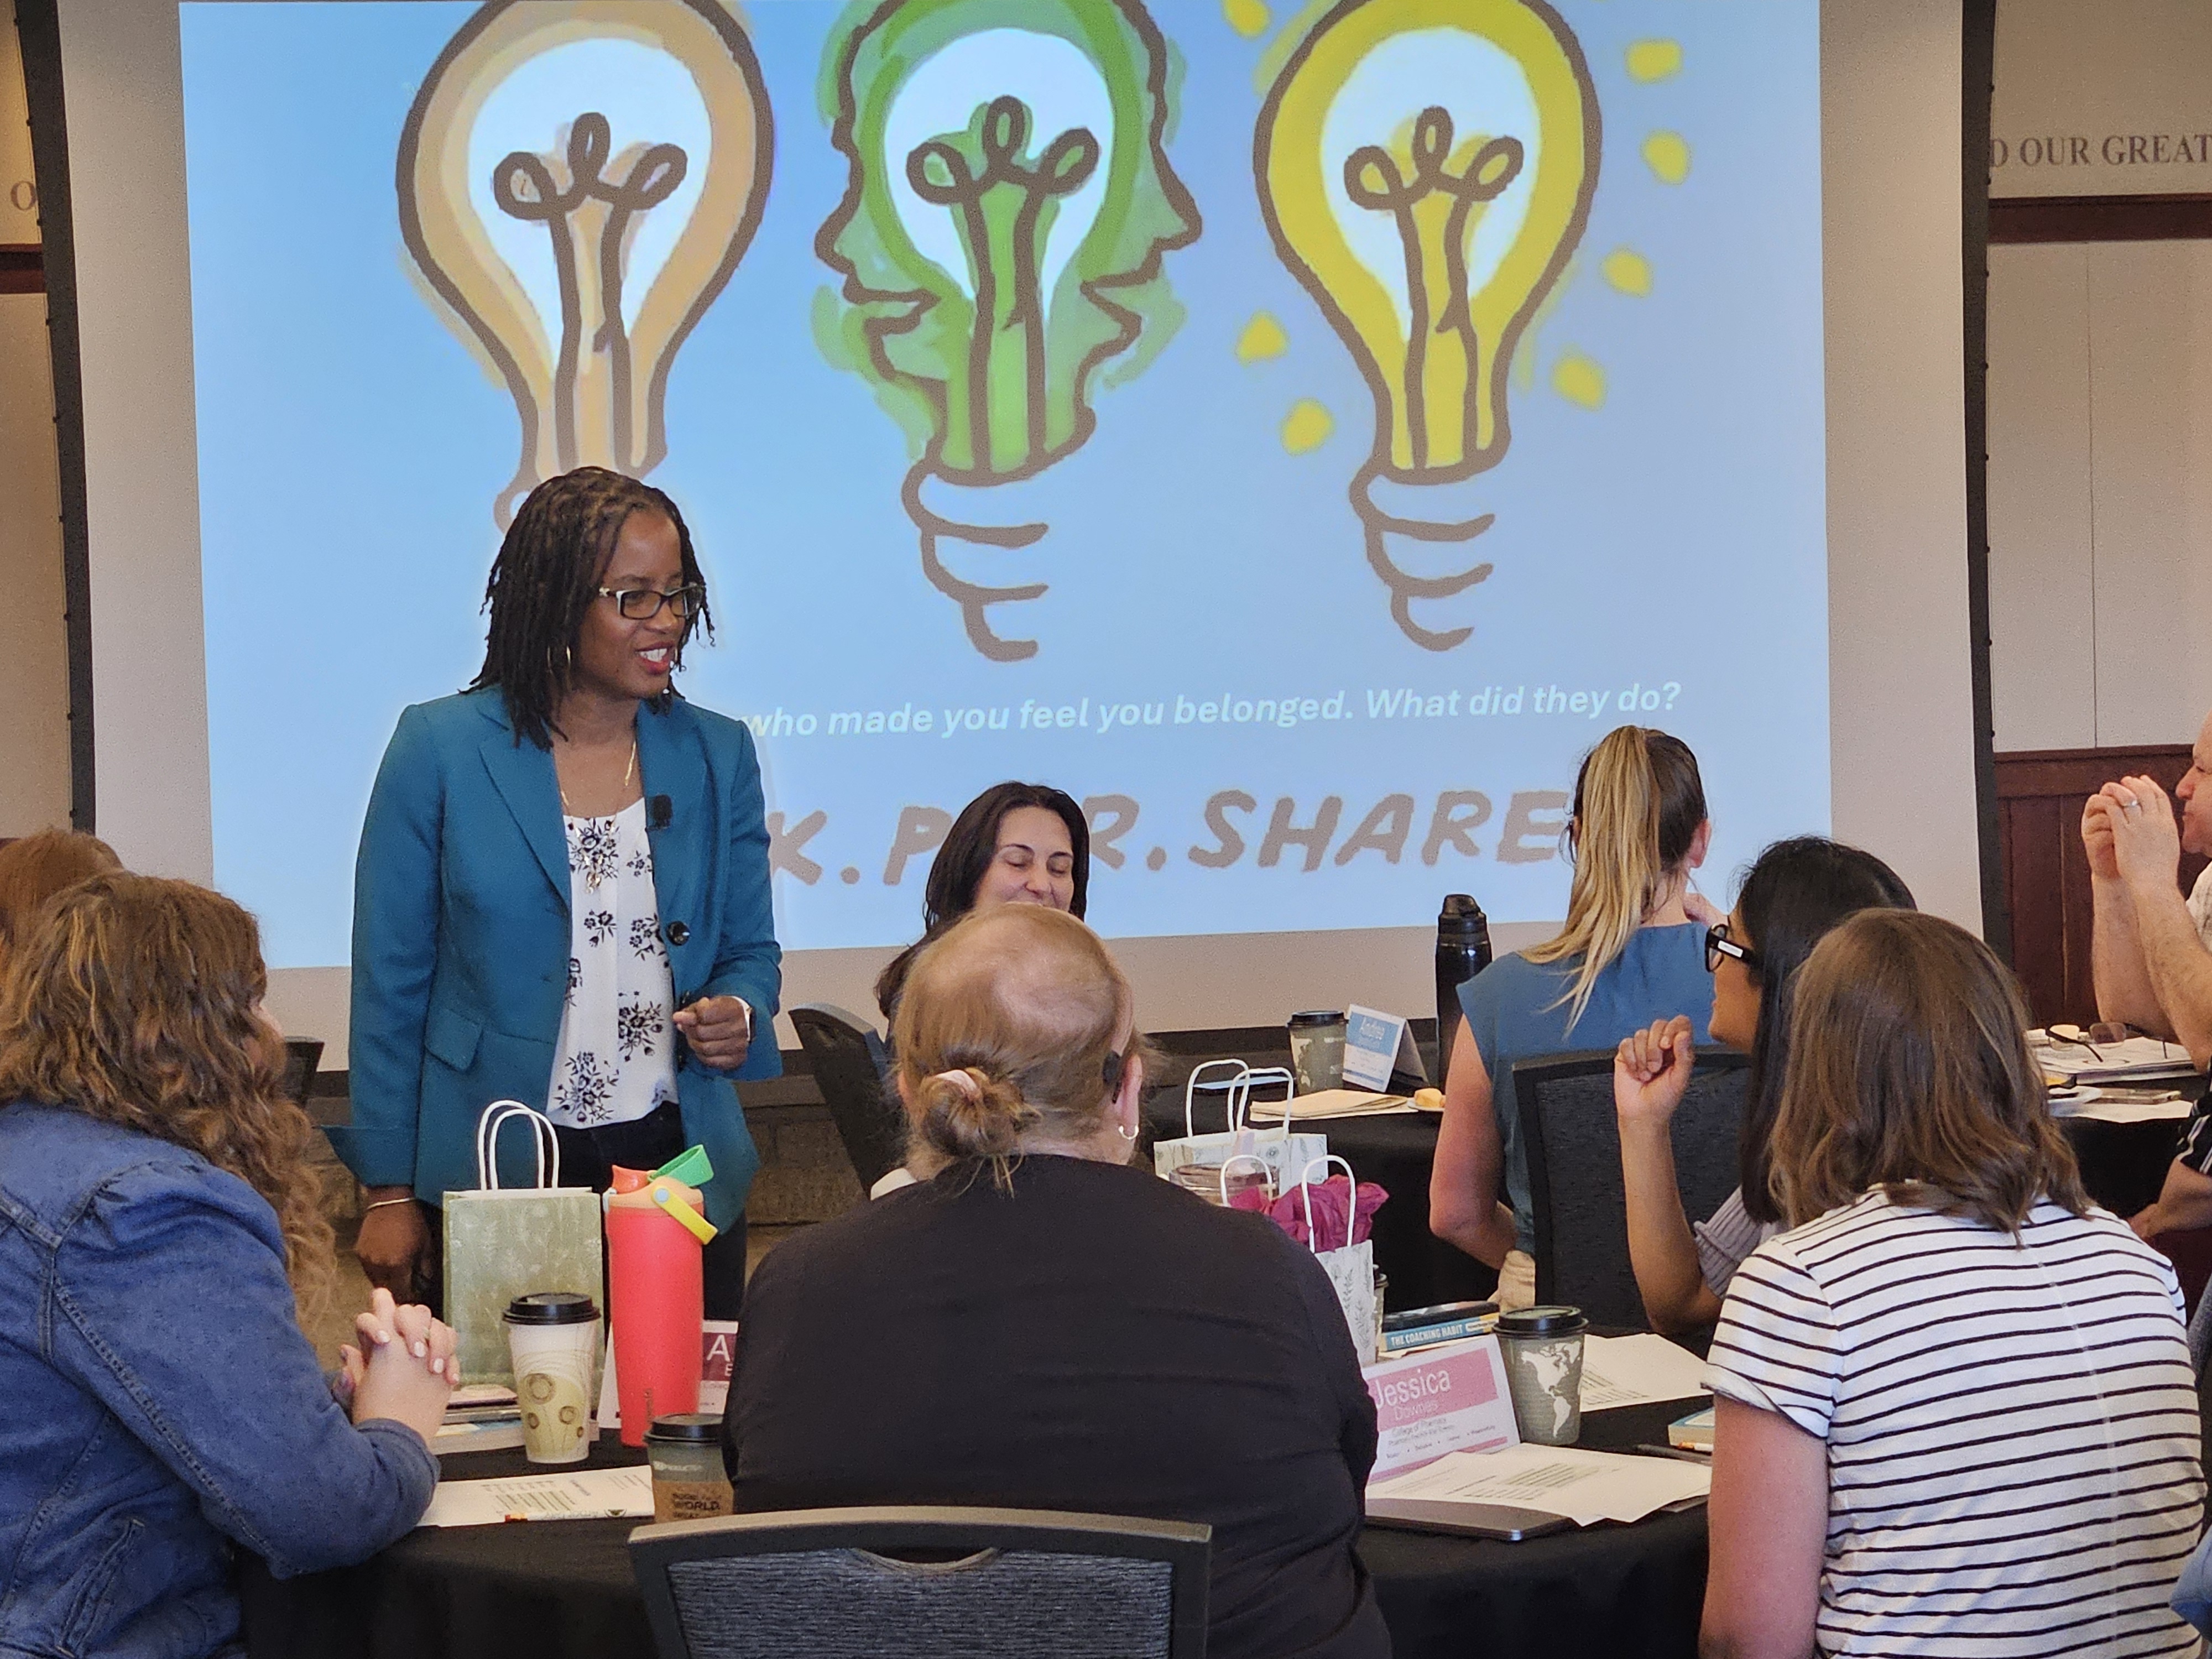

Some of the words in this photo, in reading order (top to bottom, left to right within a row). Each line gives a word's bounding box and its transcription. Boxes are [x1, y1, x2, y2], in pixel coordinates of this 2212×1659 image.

[2019, 137, 2091, 166] OUR
[2101, 134, 2212, 165] GREAT
[741, 706, 817, 737] who
[828, 702, 933, 735] made
[941, 707, 1009, 739] you
[1020, 697, 1089, 729] feel
[1097, 701, 1165, 734] you
[1174, 690, 1353, 728] belonged.
[1366, 687, 1462, 719] What
[1469, 685, 1524, 716] did
[1533, 685, 1610, 719] they
[1617, 681, 1682, 712] do?
[1391, 1336, 1405, 1346] THE
[1405, 1328, 1441, 1344] COACHING
[1441, 1324, 1463, 1337] HABIT
[1375, 1368, 1452, 1410] Jessica
